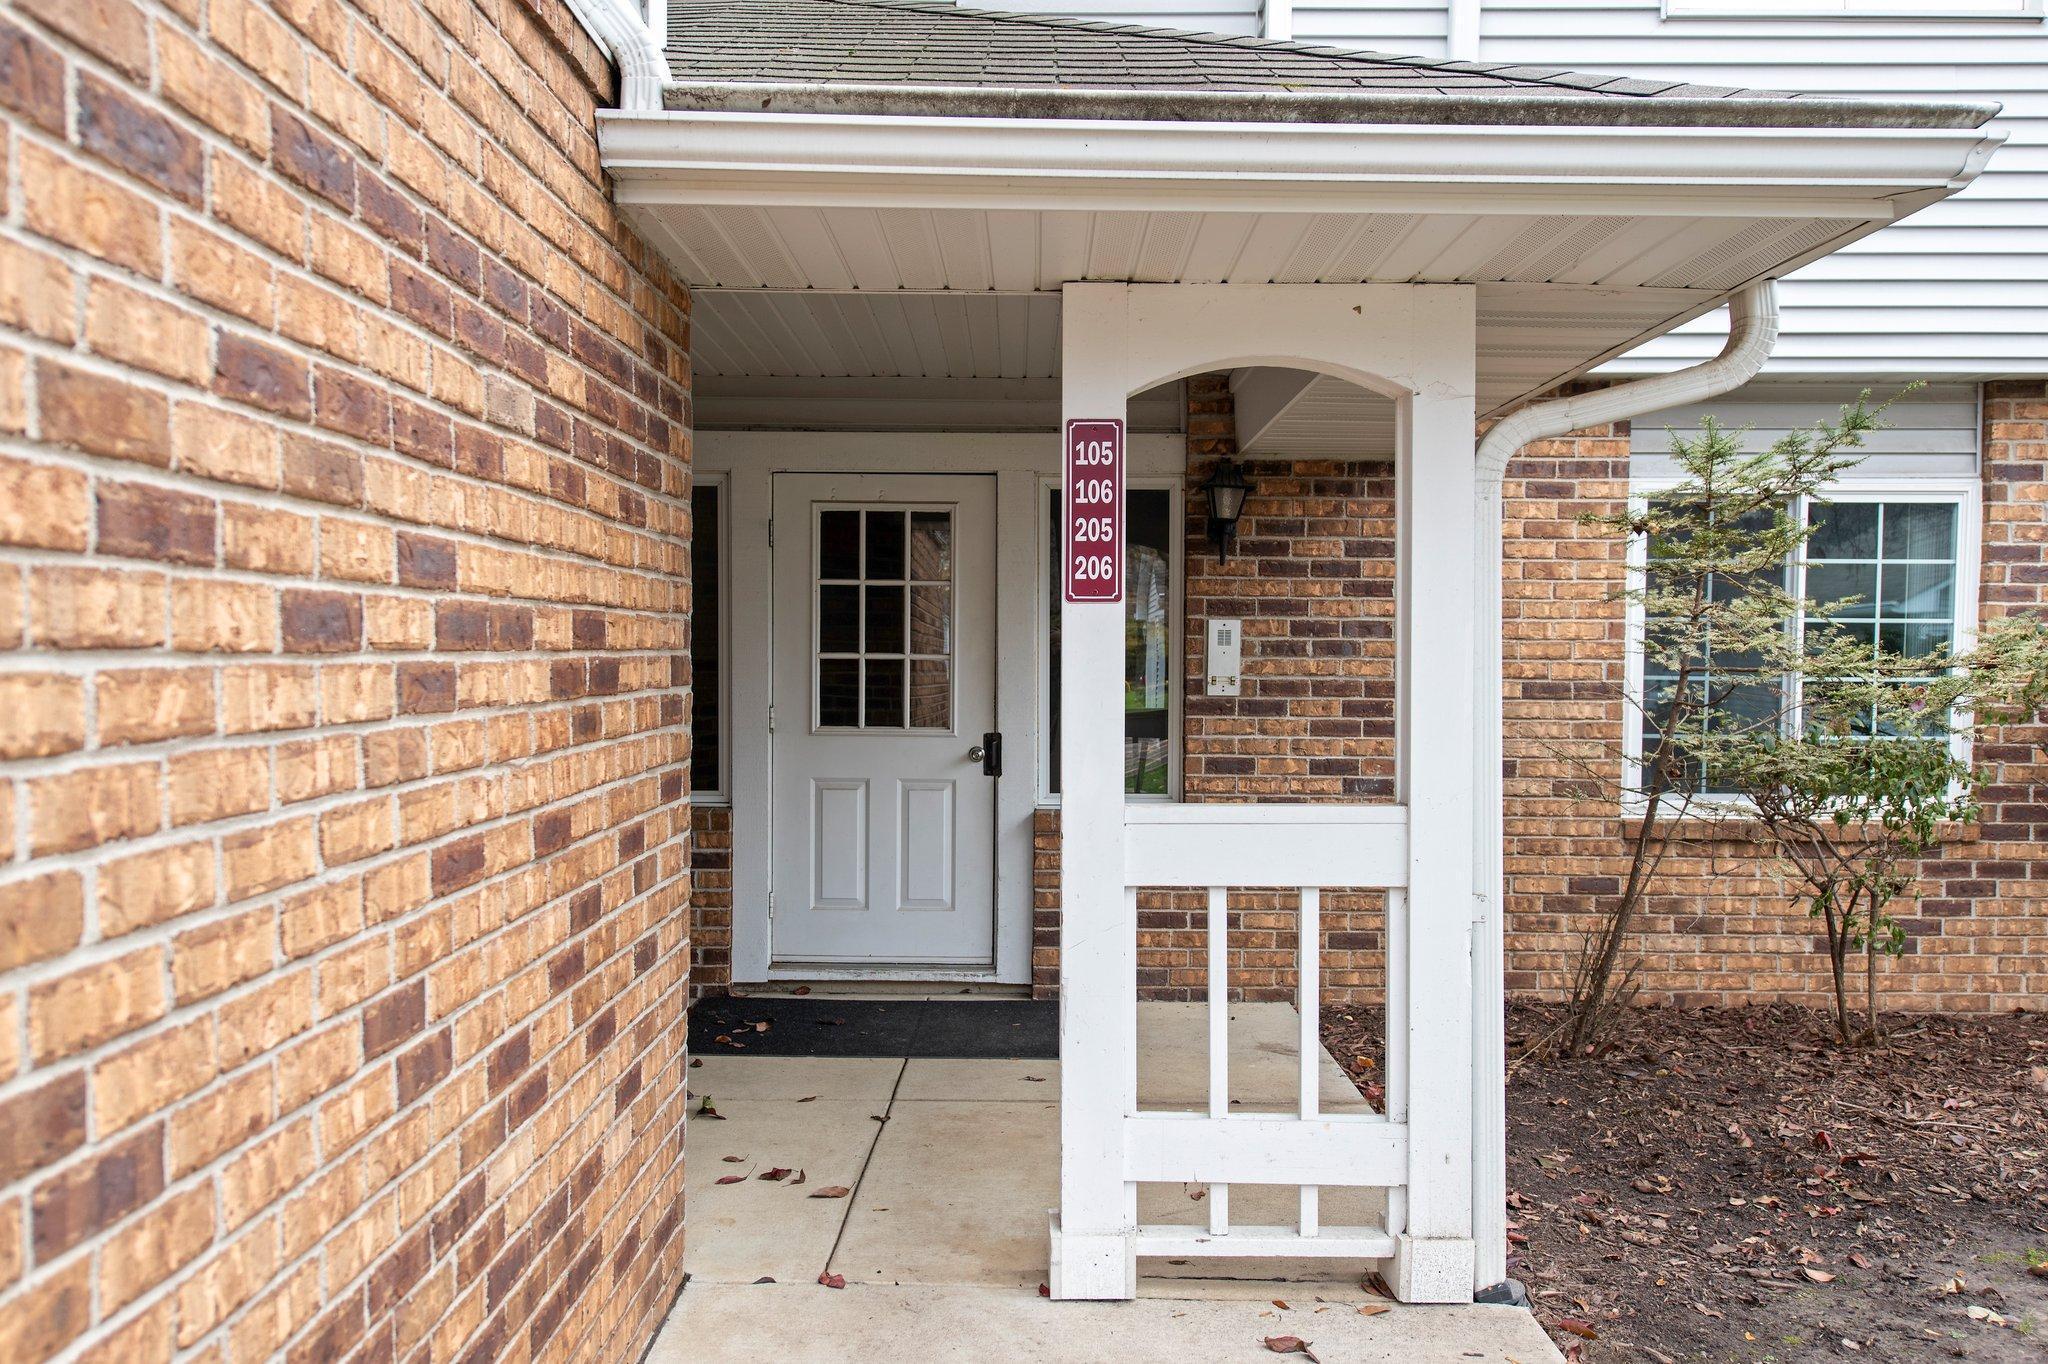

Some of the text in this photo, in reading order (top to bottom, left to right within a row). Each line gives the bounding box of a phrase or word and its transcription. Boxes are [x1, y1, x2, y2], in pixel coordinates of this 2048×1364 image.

[1075, 441, 1113, 466] 105
[1075, 479, 1113, 504] 106
[1074, 517, 1113, 542] 205
[1074, 555, 1113, 580] 206
